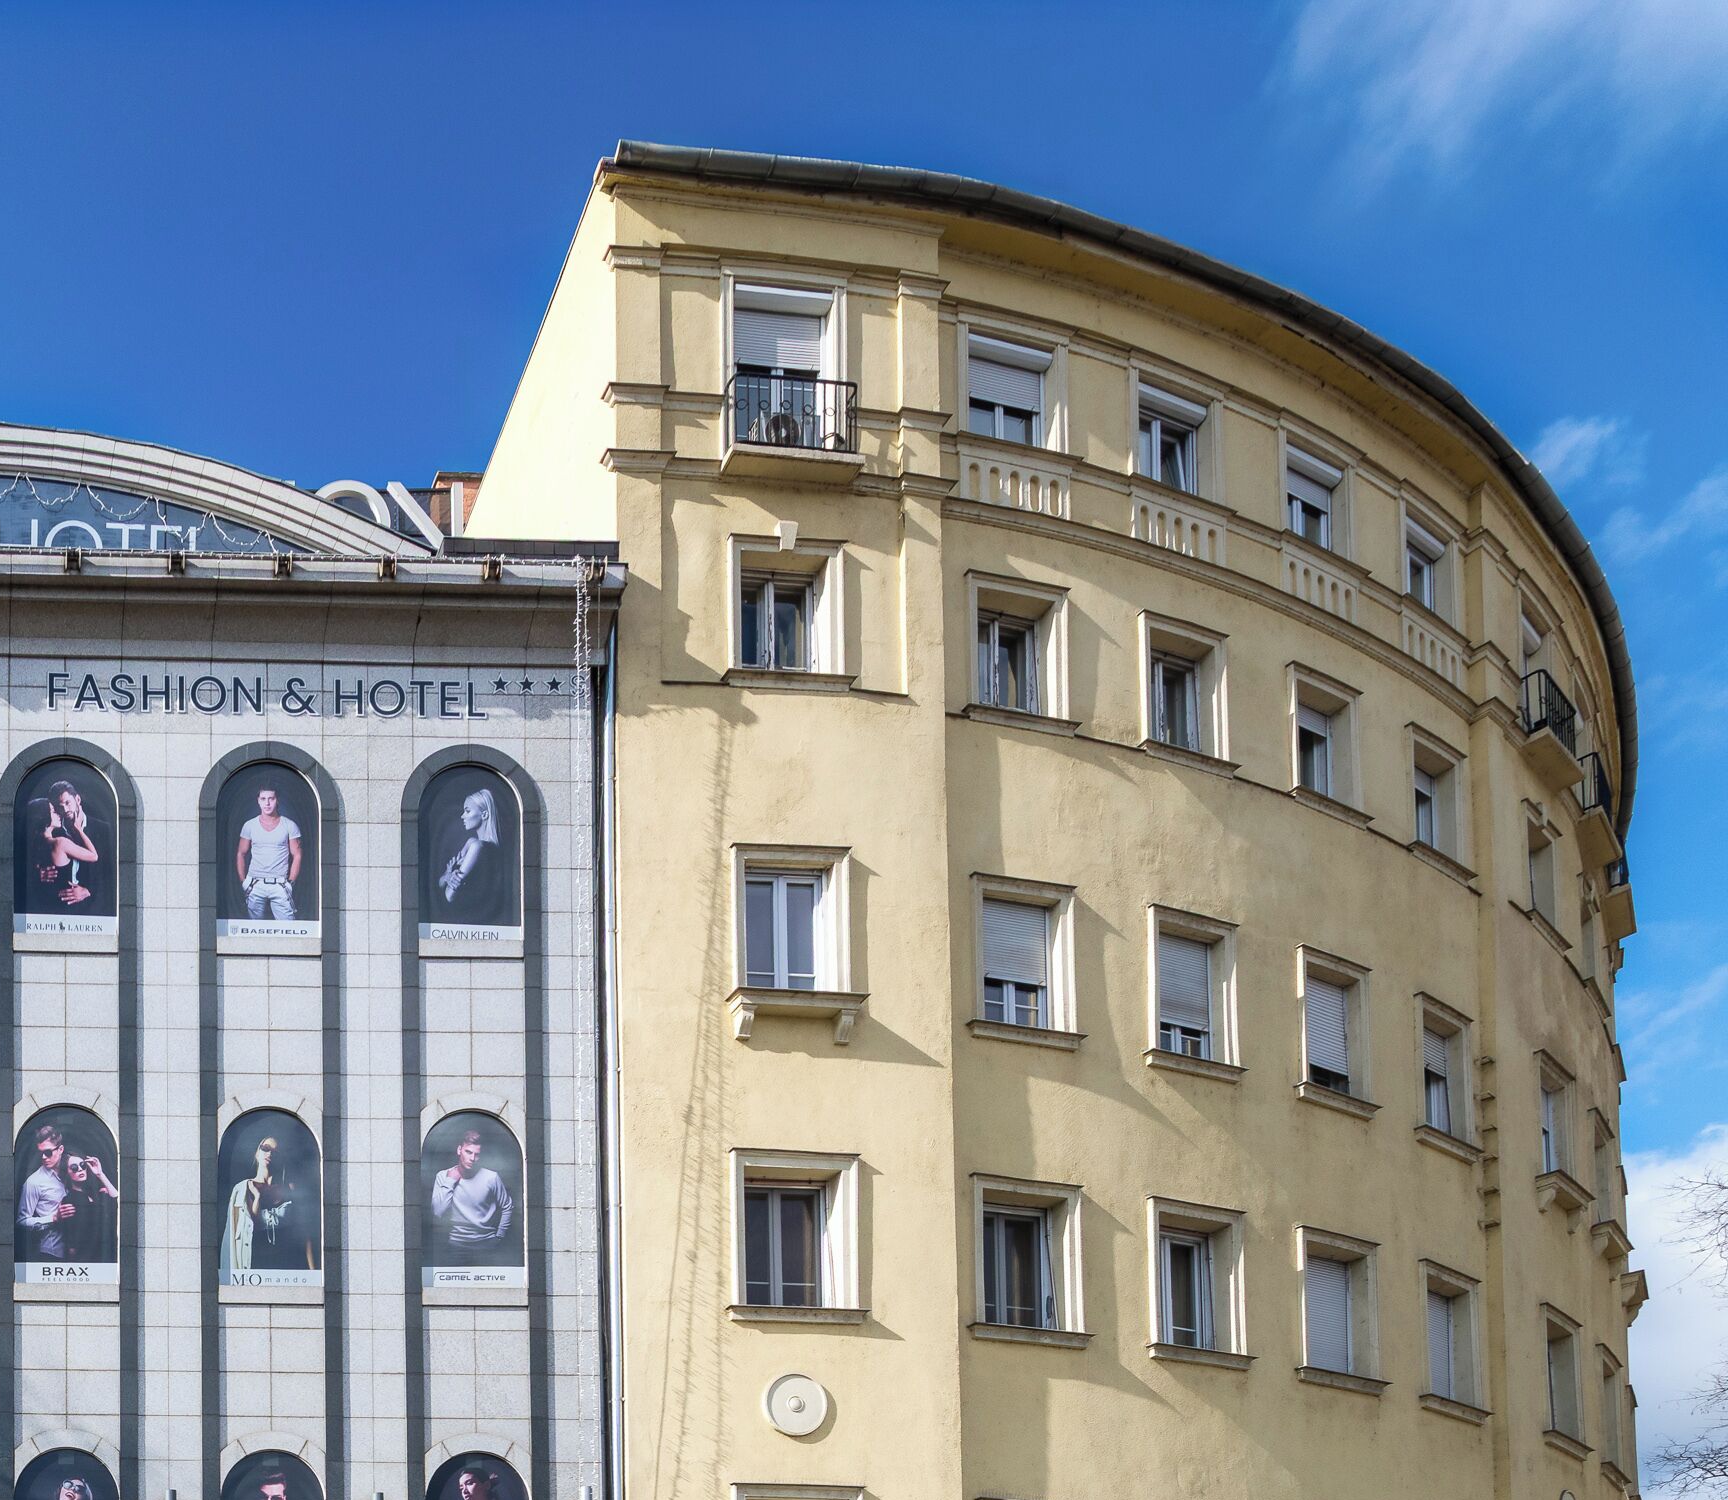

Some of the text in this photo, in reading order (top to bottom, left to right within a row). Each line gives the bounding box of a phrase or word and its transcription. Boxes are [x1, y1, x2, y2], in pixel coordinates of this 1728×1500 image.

[47, 671, 488, 719] FASHION & HOTEL
[26, 922, 104, 933] RALPH LAUREN
[240, 927, 308, 935] BASEFIELD
[432, 929, 499, 941] CALVIN KLEIN
[42, 1266, 89, 1277] BRAX
